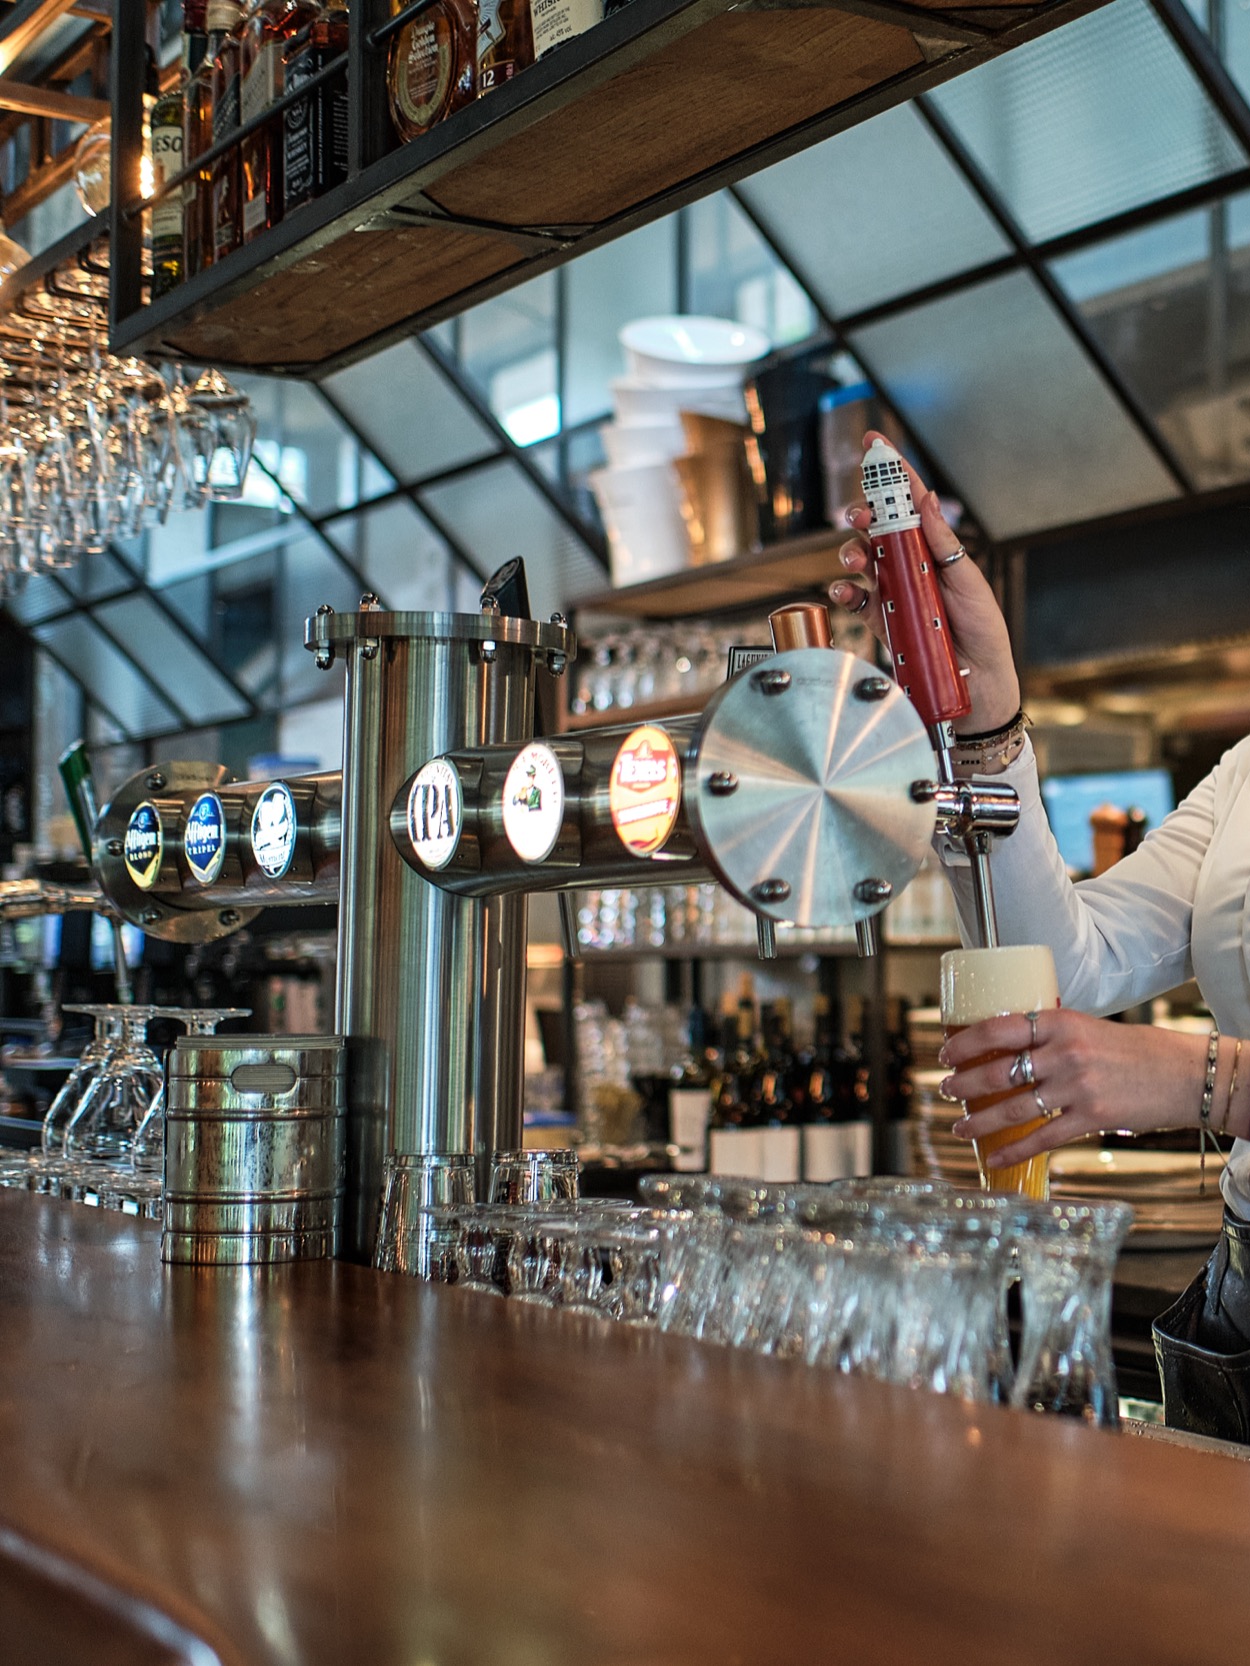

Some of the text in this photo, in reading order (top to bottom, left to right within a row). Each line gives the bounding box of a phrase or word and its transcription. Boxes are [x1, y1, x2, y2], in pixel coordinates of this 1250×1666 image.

[482, 69, 495, 88] 12
[409, 783, 455, 843] IPA
[129, 851, 153, 862] BLOND
[187, 844, 216, 856] TRIPEL
